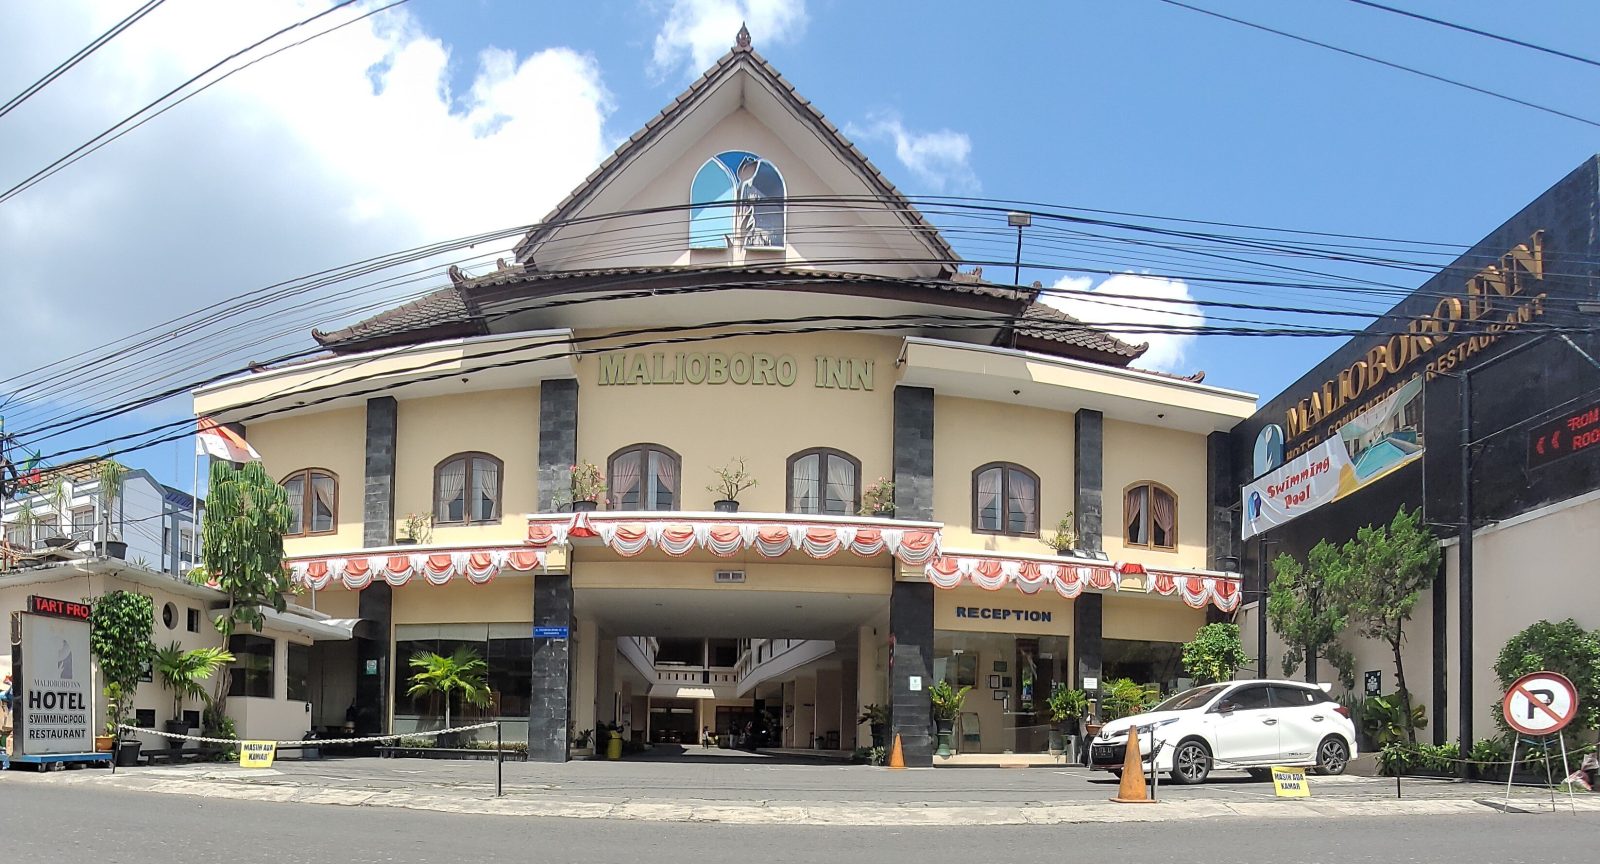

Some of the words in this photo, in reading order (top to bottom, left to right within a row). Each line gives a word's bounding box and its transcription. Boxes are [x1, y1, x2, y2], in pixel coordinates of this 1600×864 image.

[1286, 297, 1462, 443] MALIOBORO
[1465, 229, 1545, 321] INN
[598, 352, 797, 386] MALIOBORO
[815, 355, 875, 391] INN
[1267, 456, 1330, 498] Swimming
[1284, 483, 1311, 509] Pool
[35, 597, 63, 614] TART
[66, 604, 89, 618] FRO
[956, 606, 1052, 622] RECEPTION
[34, 679, 70, 688] MALIOBORO
[28, 690, 86, 710] HOTEL
[29, 714, 68, 724] SWIMMING
[69, 715, 86, 724] POOL
[29, 729, 86, 739] RESTAURANT
[1274, 773, 1292, 781] MASIH
[1292, 773, 1304, 781] ADA
[1280, 782, 1301, 790] KAMAR
